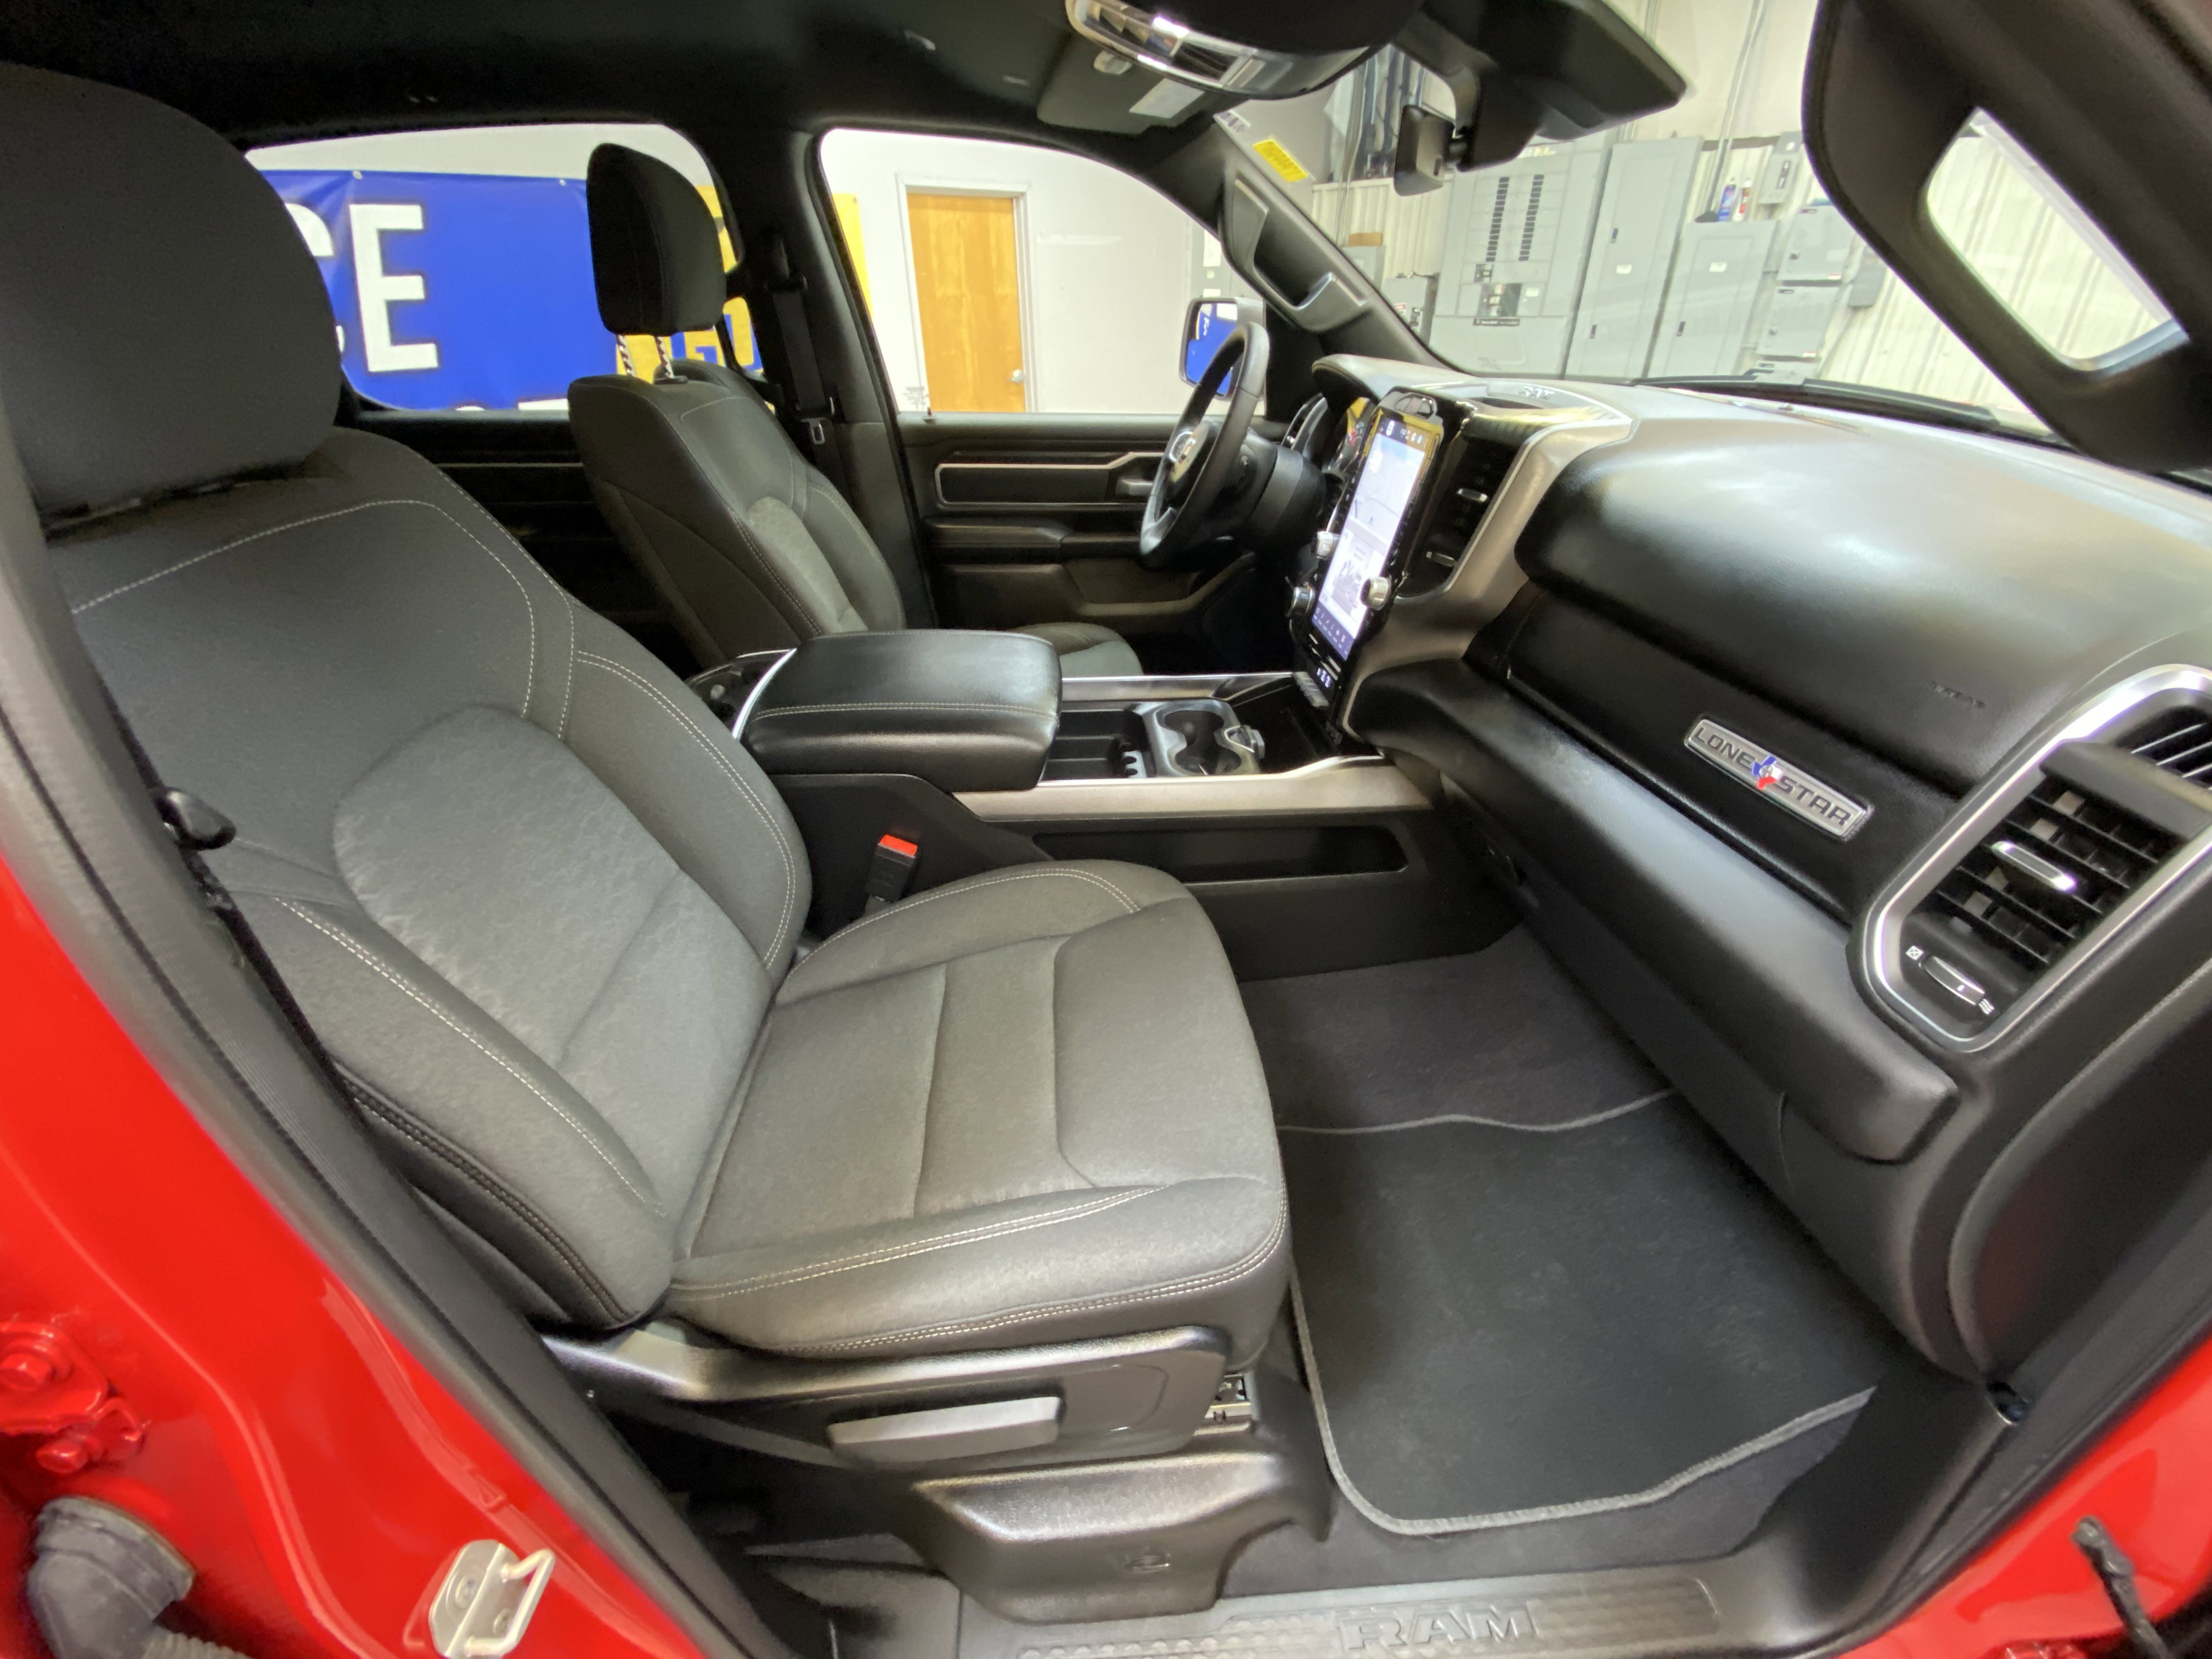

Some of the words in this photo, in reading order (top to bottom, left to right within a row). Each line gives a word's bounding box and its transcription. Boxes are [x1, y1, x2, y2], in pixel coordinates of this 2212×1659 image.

[285, 203, 439, 373] E
[1694, 727, 1756, 768] LONE
[1776, 775, 1851, 826] STAR
[1338, 1600, 1542, 1650] RAM
